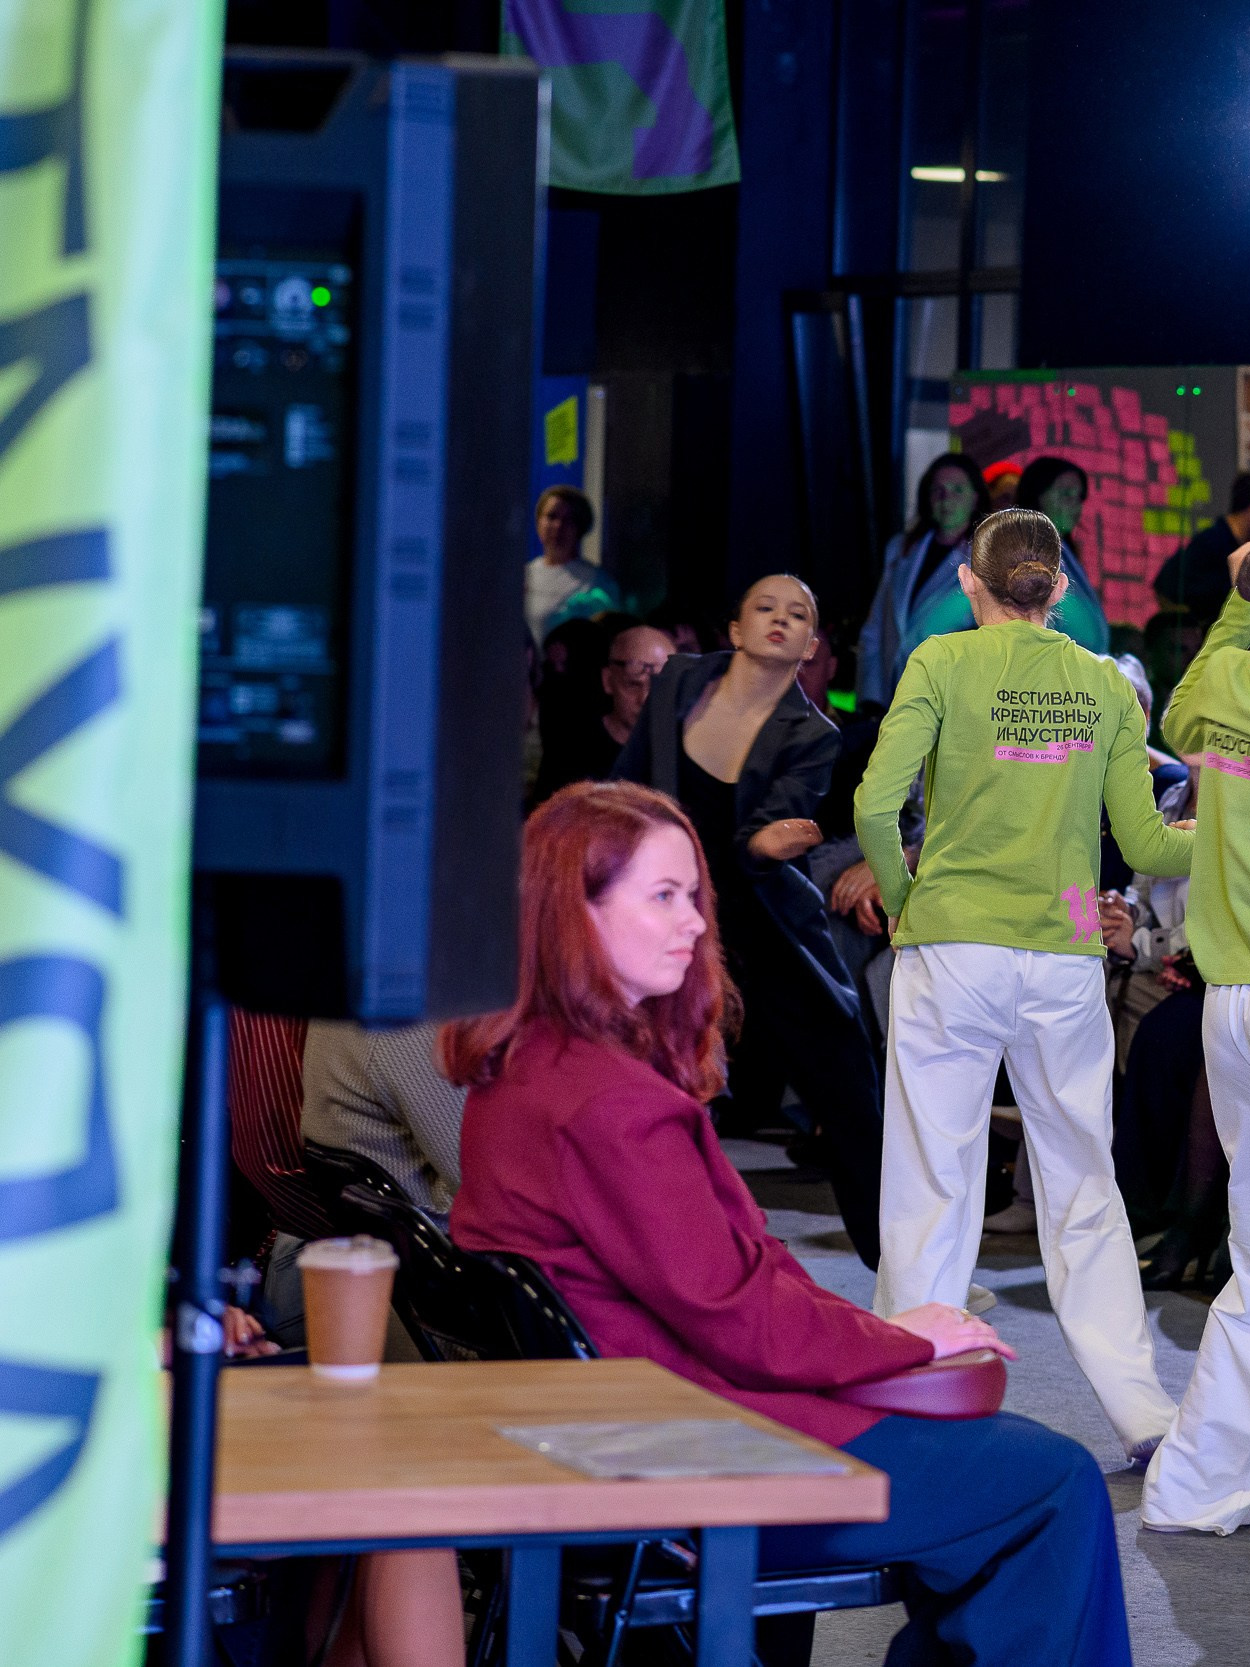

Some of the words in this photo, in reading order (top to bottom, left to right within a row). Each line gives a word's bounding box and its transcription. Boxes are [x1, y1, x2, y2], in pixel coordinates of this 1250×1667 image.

[996, 688, 1097, 707] ФЕСТИВАЛЬ
[990, 706, 1102, 726] КРЕАТИВНЫХ
[996, 725, 1094, 746] ИНДУСТРИЙ
[1040, 753, 1066, 761] БРЕНДУ
